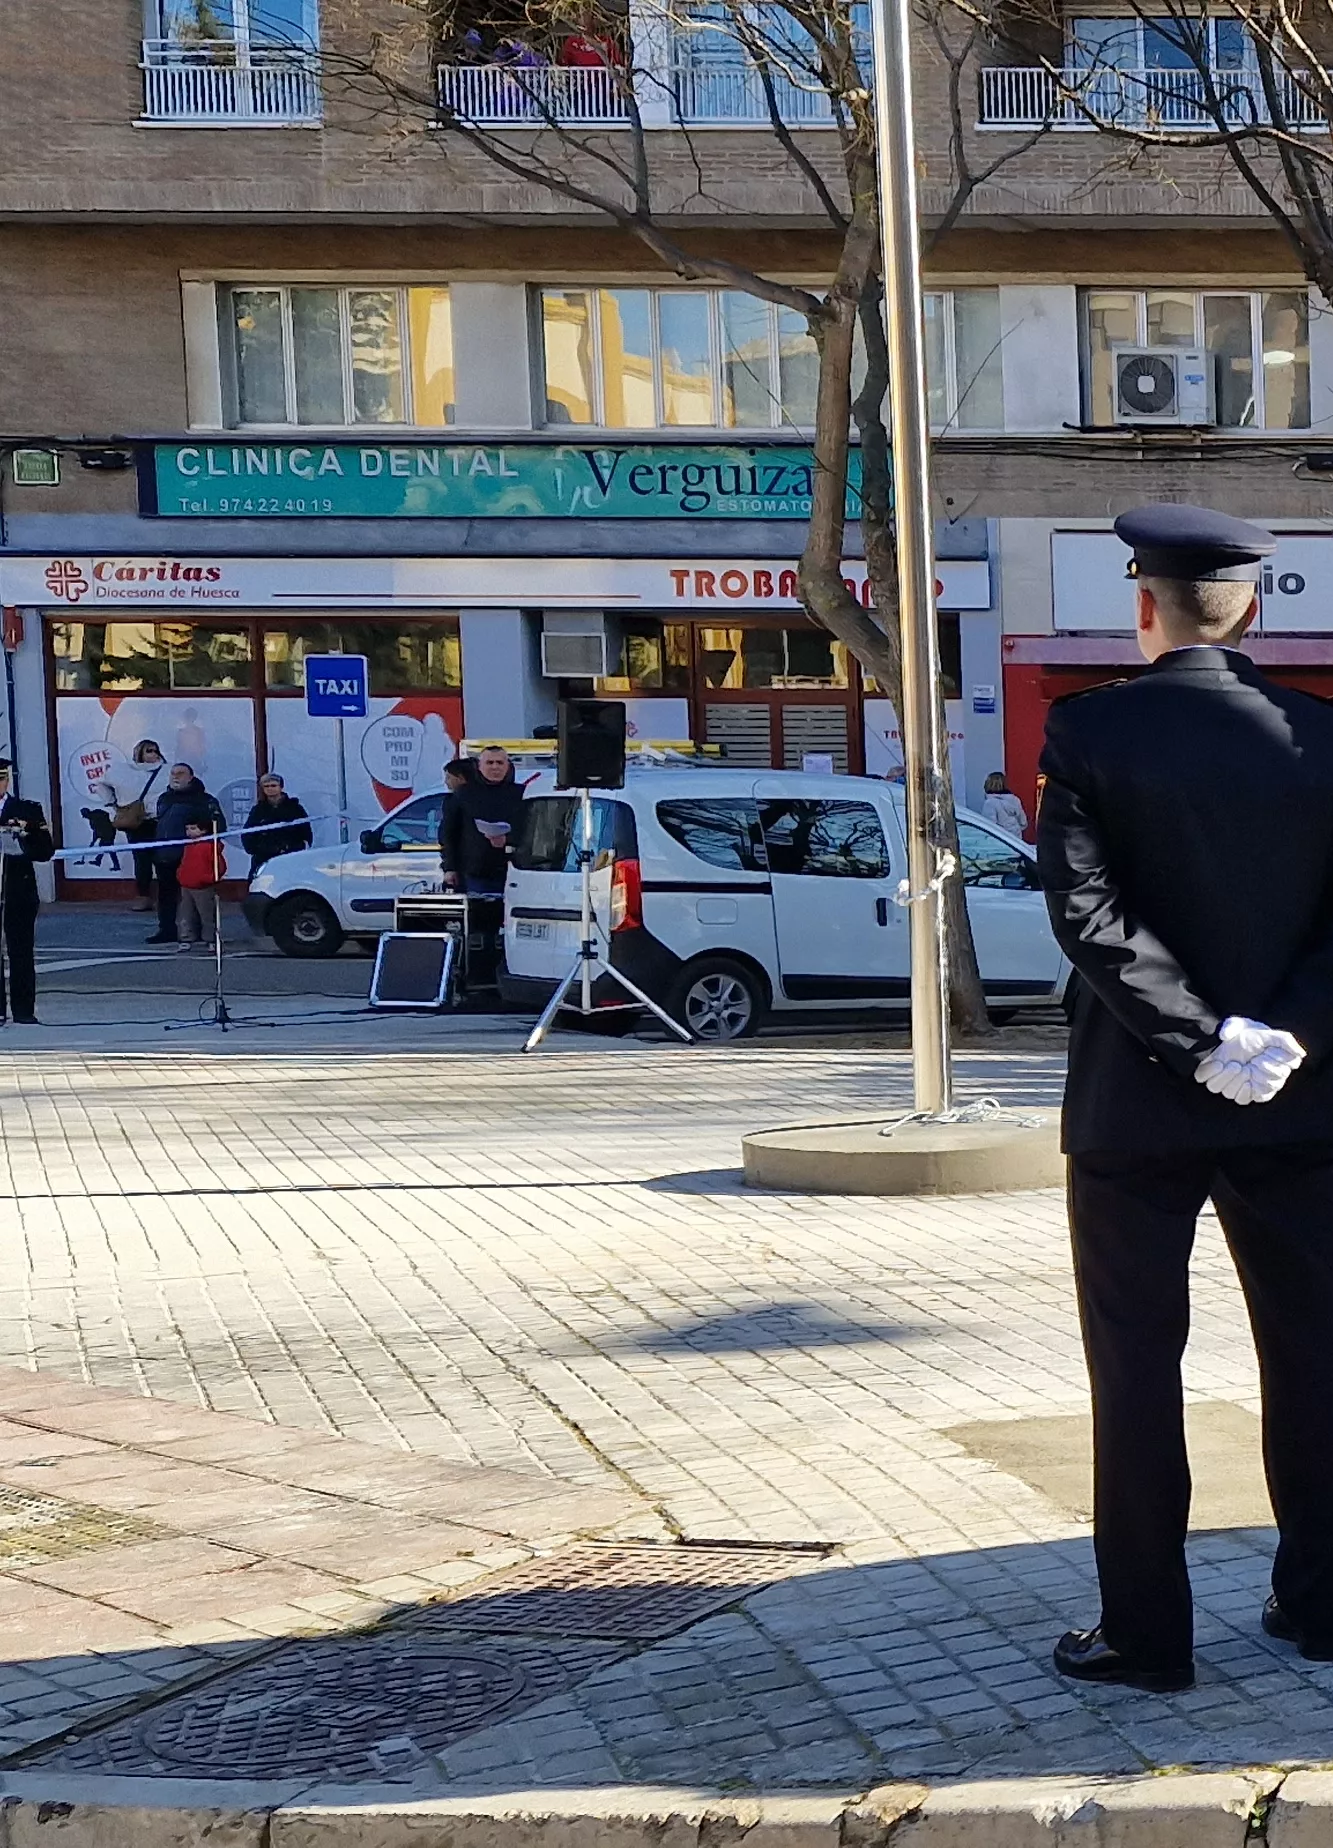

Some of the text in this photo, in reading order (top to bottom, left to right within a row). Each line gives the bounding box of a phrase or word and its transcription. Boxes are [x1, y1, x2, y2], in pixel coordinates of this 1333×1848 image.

[176, 448, 519, 478] CLINICA DENTAL
[584, 448, 813, 512] Verguiza
[179, 499, 214, 512] Tel.
[93, 560, 221, 582] Cáritas
[96, 586, 240, 599] Diocesana de Huesca
[314, 679, 358, 695] TAXI
[383, 727, 414, 738] COM
[385, 741, 412, 752] PRO
[80, 749, 112, 767] INTE
[391, 770, 409, 780] SO
